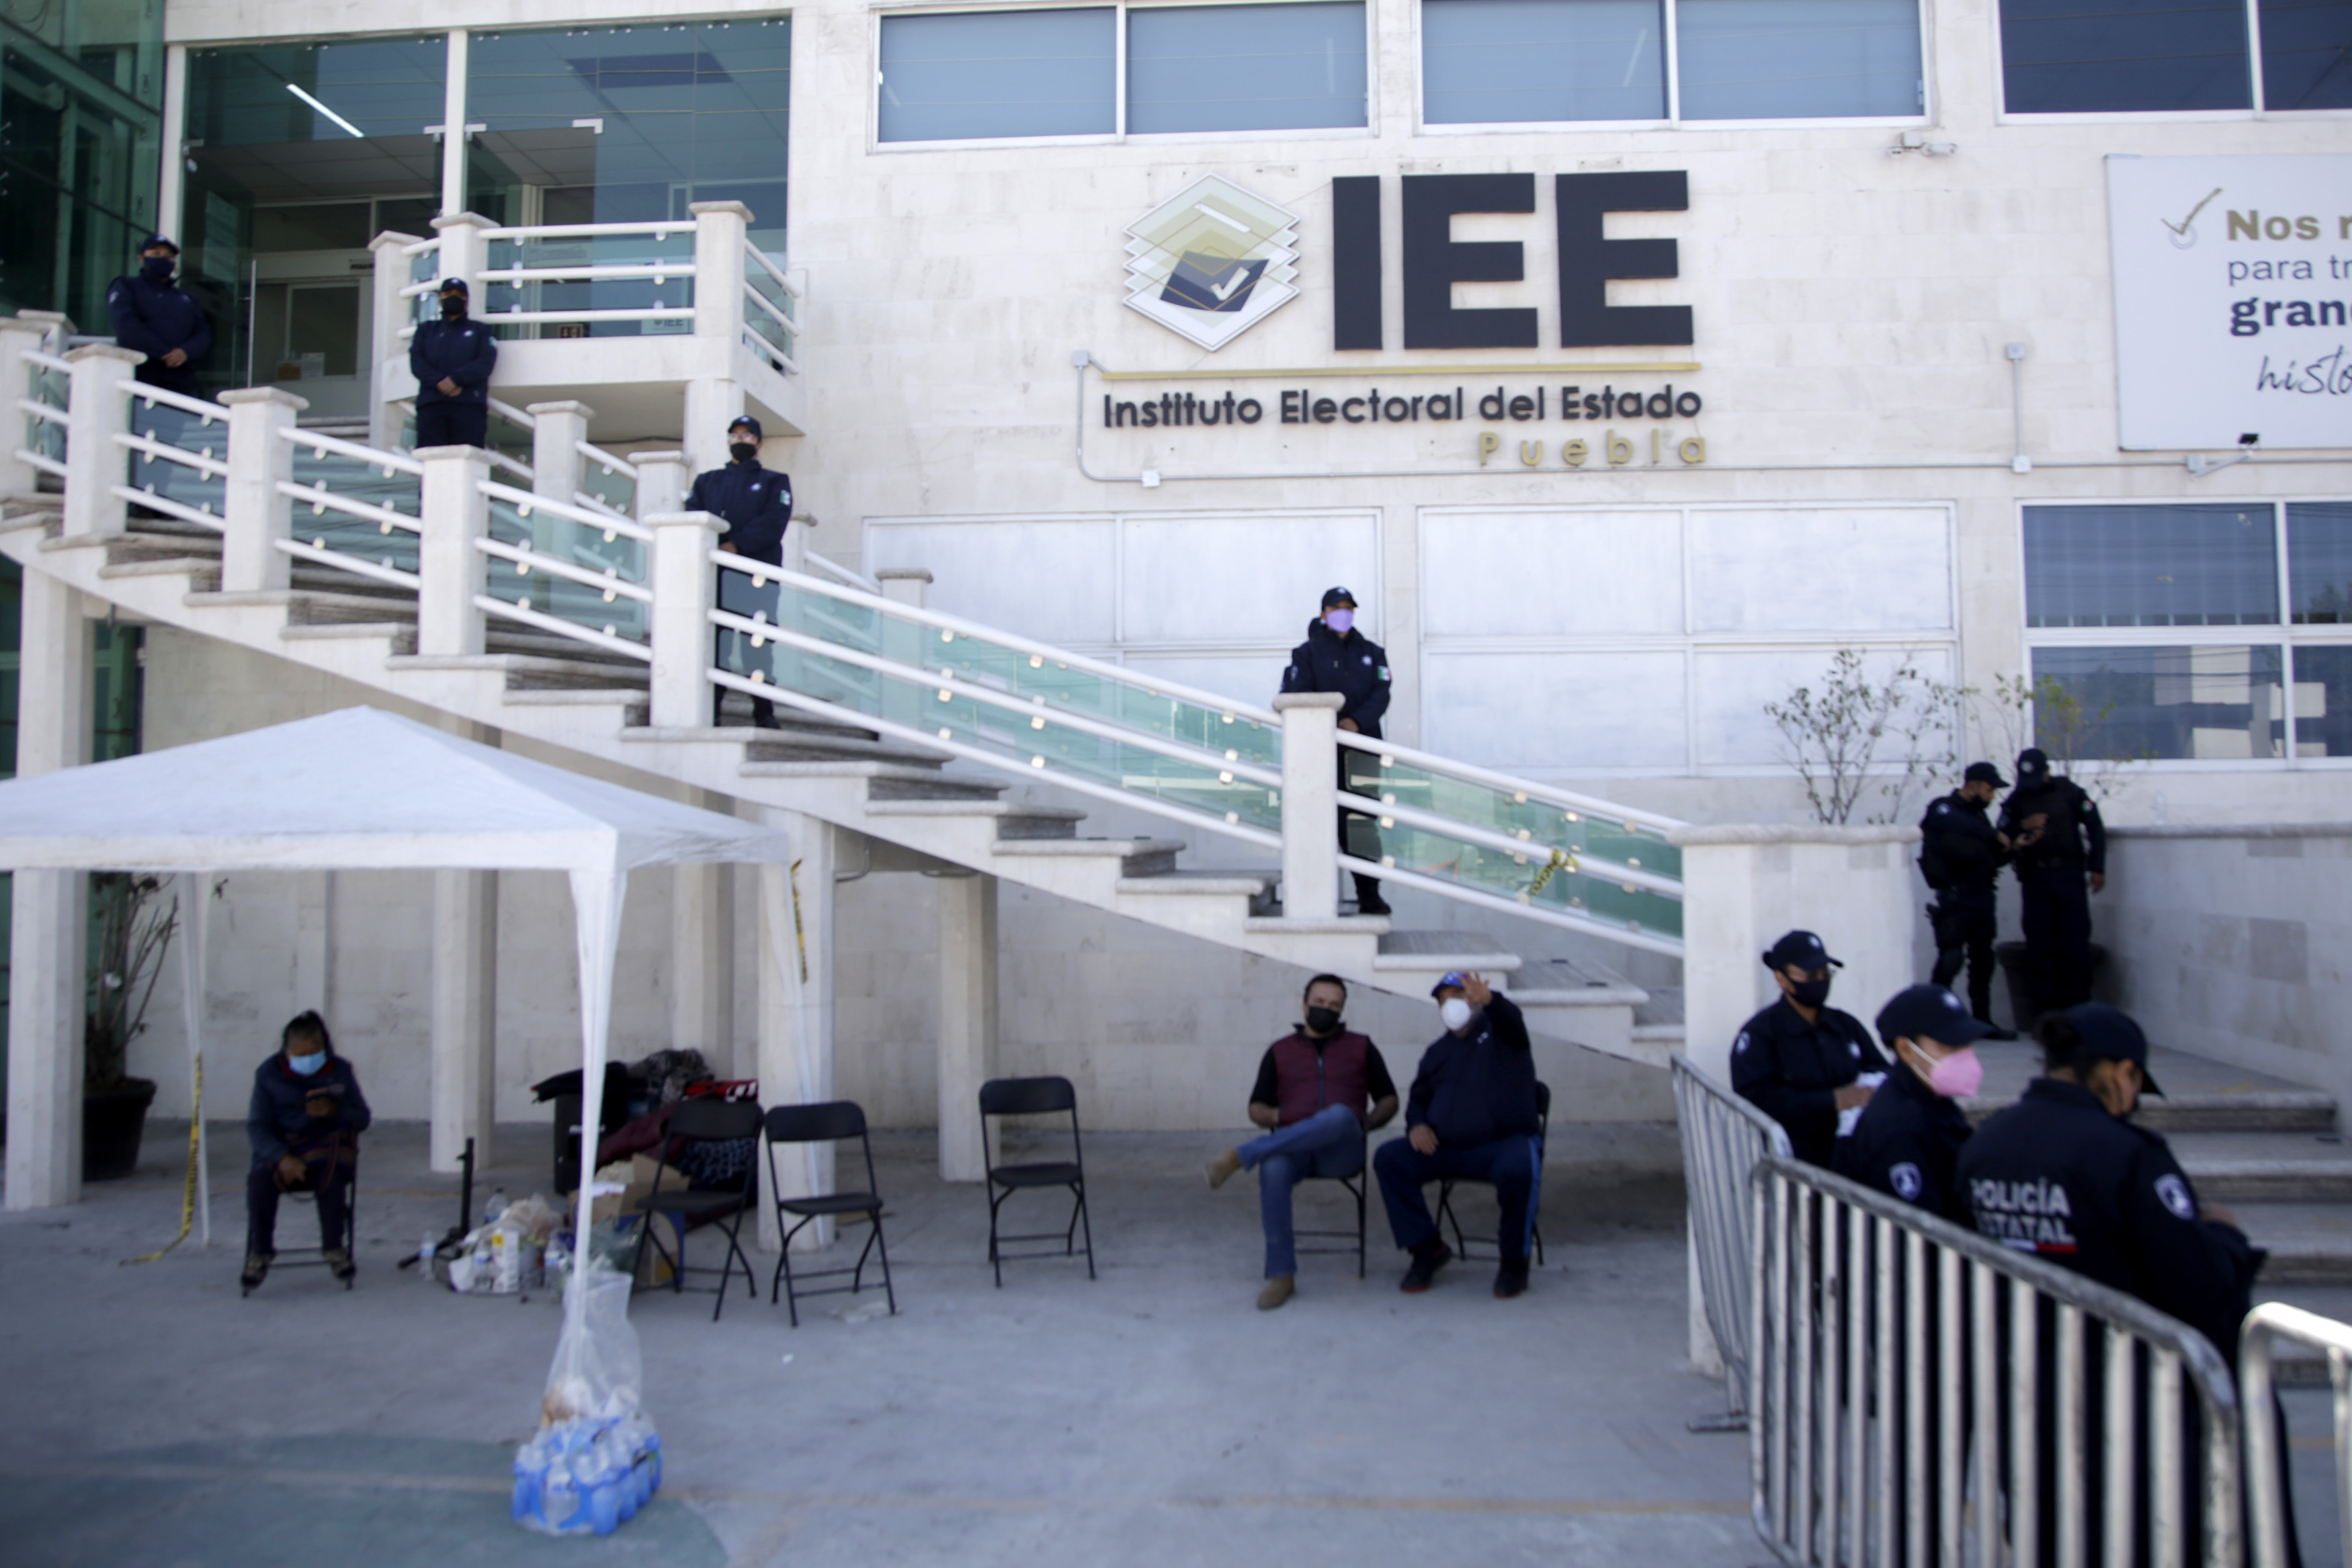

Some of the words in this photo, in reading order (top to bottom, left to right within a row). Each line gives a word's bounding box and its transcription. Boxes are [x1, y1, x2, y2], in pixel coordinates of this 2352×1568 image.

[2227, 210, 2320, 241] Nos
[1333, 171, 1693, 351] IEE
[2228, 259, 2314, 286] para
[2230, 296, 2352, 337] gran
[1103, 390, 1263, 429] Instituto
[1280, 386, 1464, 425] Electoral
[1478, 386, 1546, 422] del
[1560, 384, 1703, 421] Estado
[1480, 429, 1705, 468] Puebla
